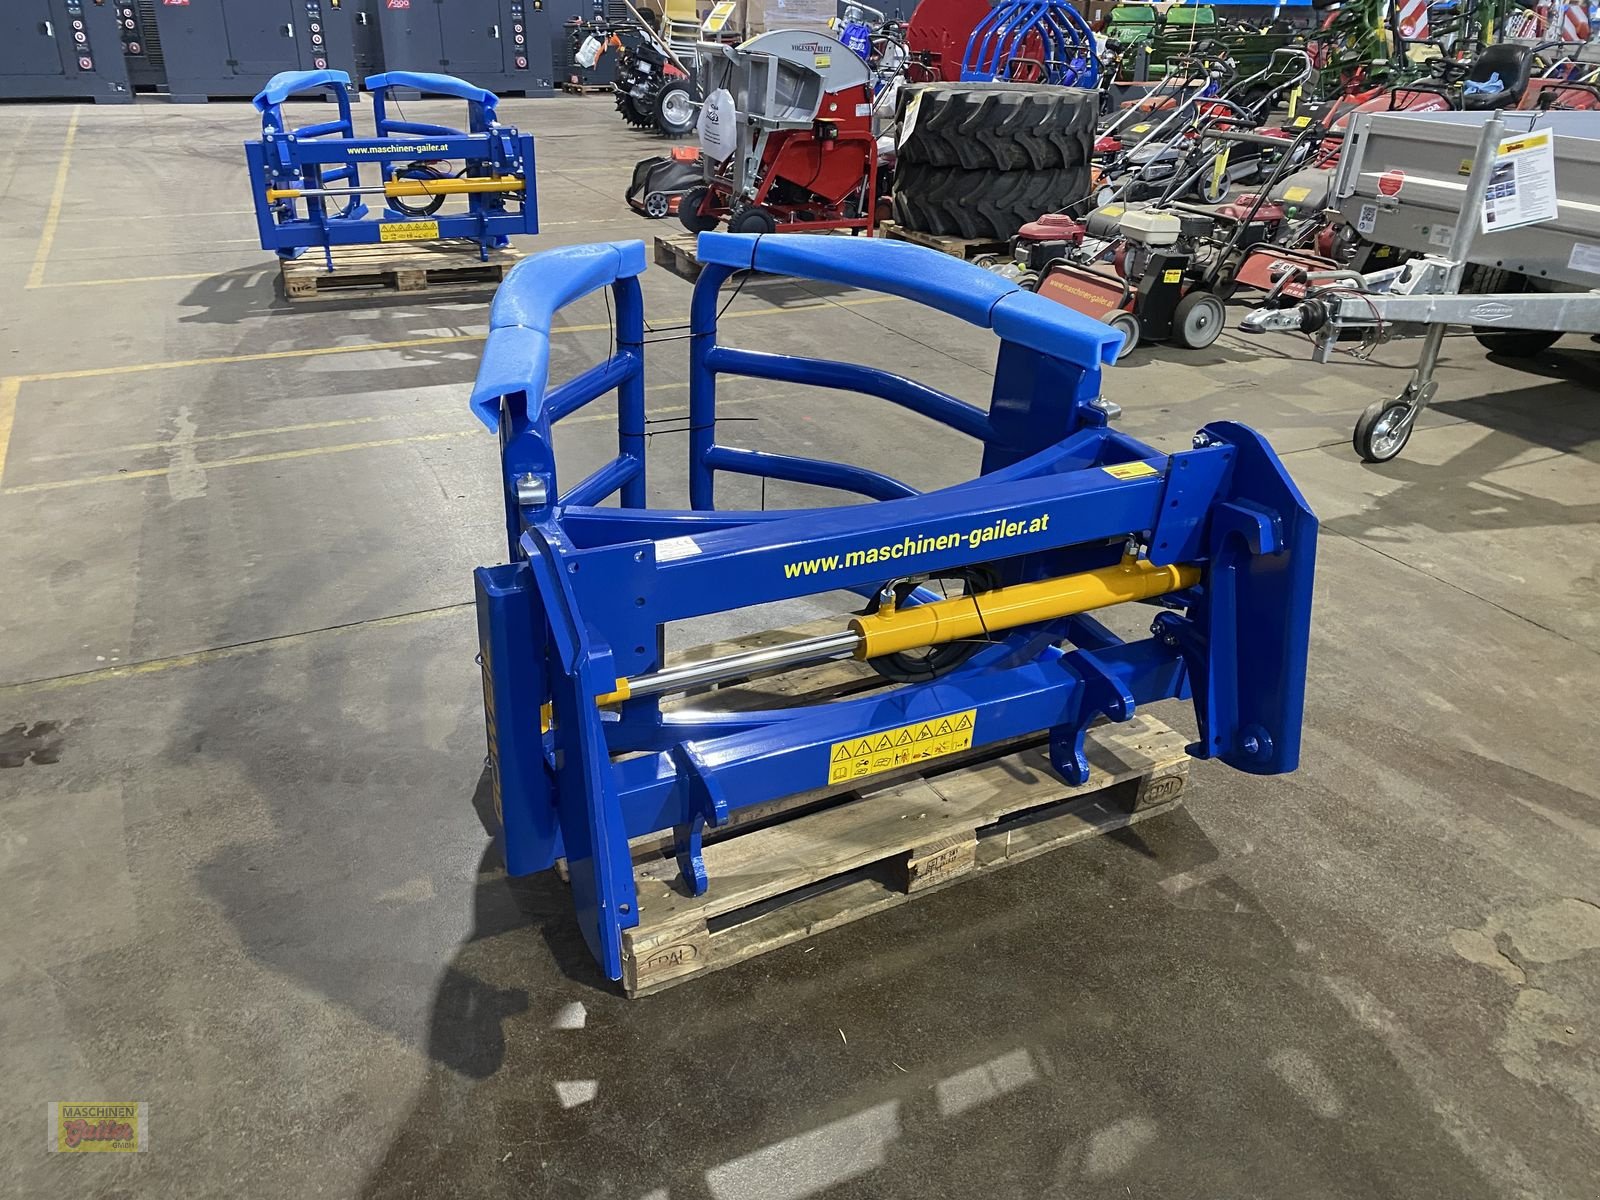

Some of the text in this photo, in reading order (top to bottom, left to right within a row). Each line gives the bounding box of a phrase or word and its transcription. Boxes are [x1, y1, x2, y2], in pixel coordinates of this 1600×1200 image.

[347, 143, 448, 154] www.maschinen-gailer.at
[1049, 279, 1115, 308] www.maschinen-gailer.at
[784, 513, 1050, 579] www.maschinen-gailer.at
